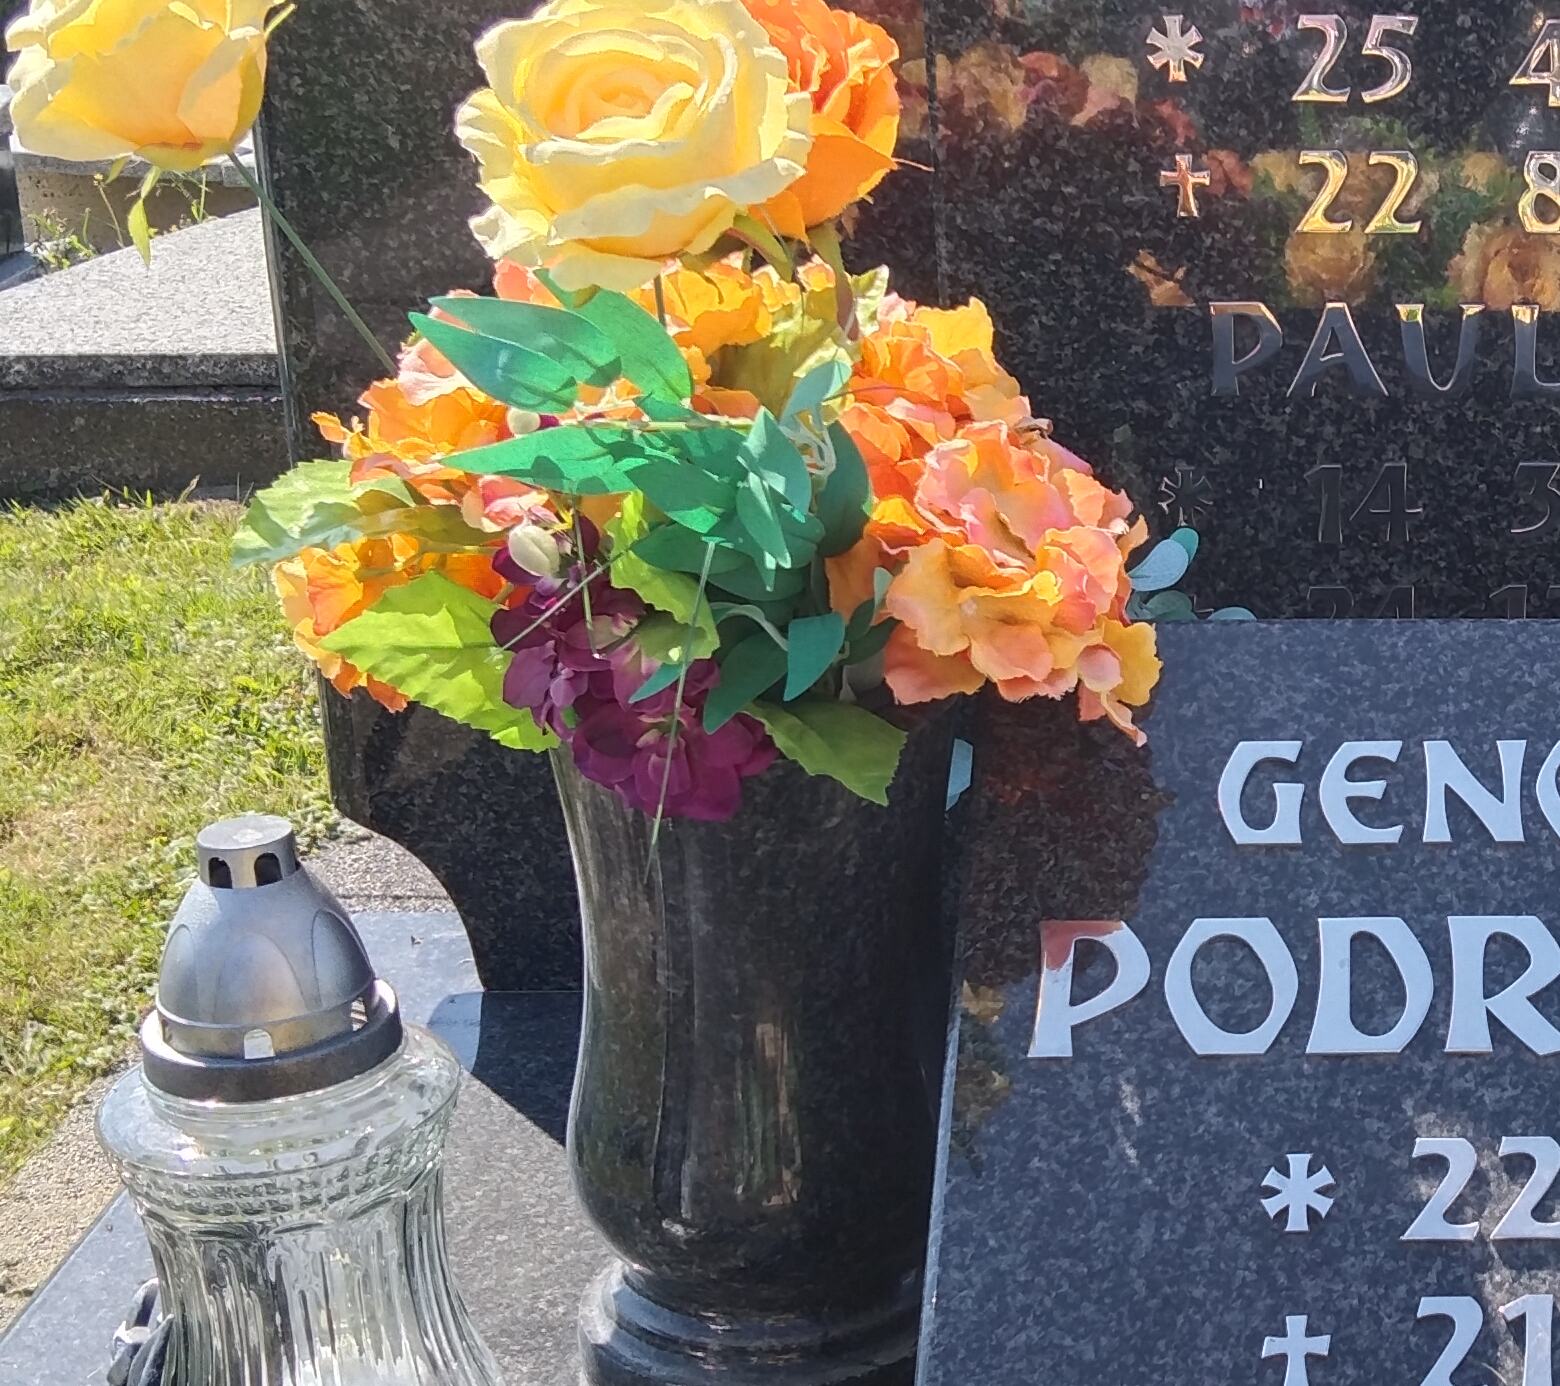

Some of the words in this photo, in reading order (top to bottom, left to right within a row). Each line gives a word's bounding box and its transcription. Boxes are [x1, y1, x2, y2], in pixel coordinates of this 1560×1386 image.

[1291, 15, 1419, 105] 25
[1296, 150, 1423, 234] 22
[1304, 462, 1423, 543] 14
